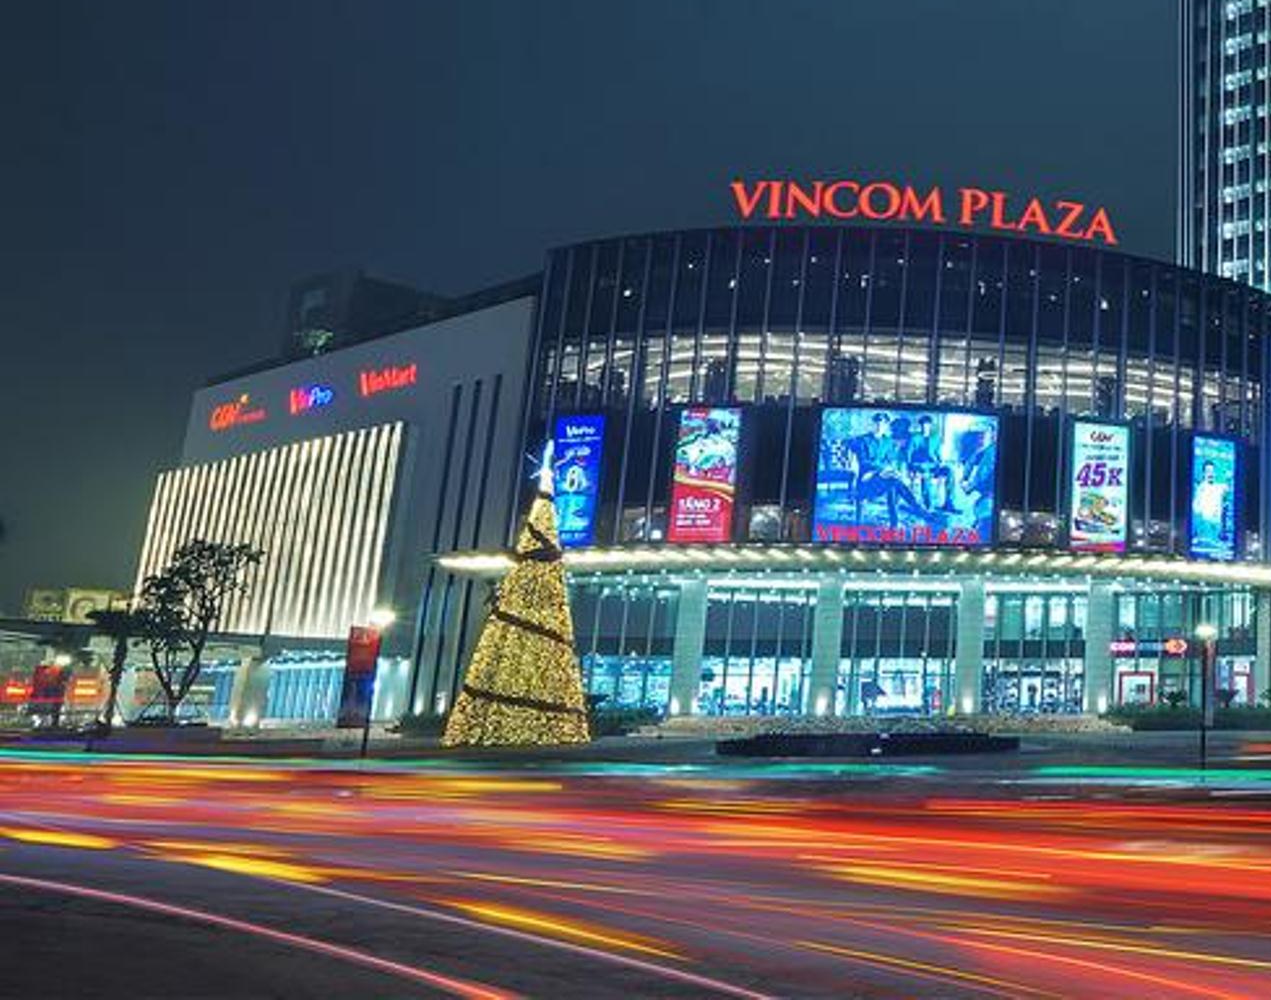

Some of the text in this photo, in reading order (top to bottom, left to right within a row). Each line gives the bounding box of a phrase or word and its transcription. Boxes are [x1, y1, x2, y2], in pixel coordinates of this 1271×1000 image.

[730, 180, 1118, 246] VINCOM PLAZA
[1076, 461, 1123, 488] 45K
